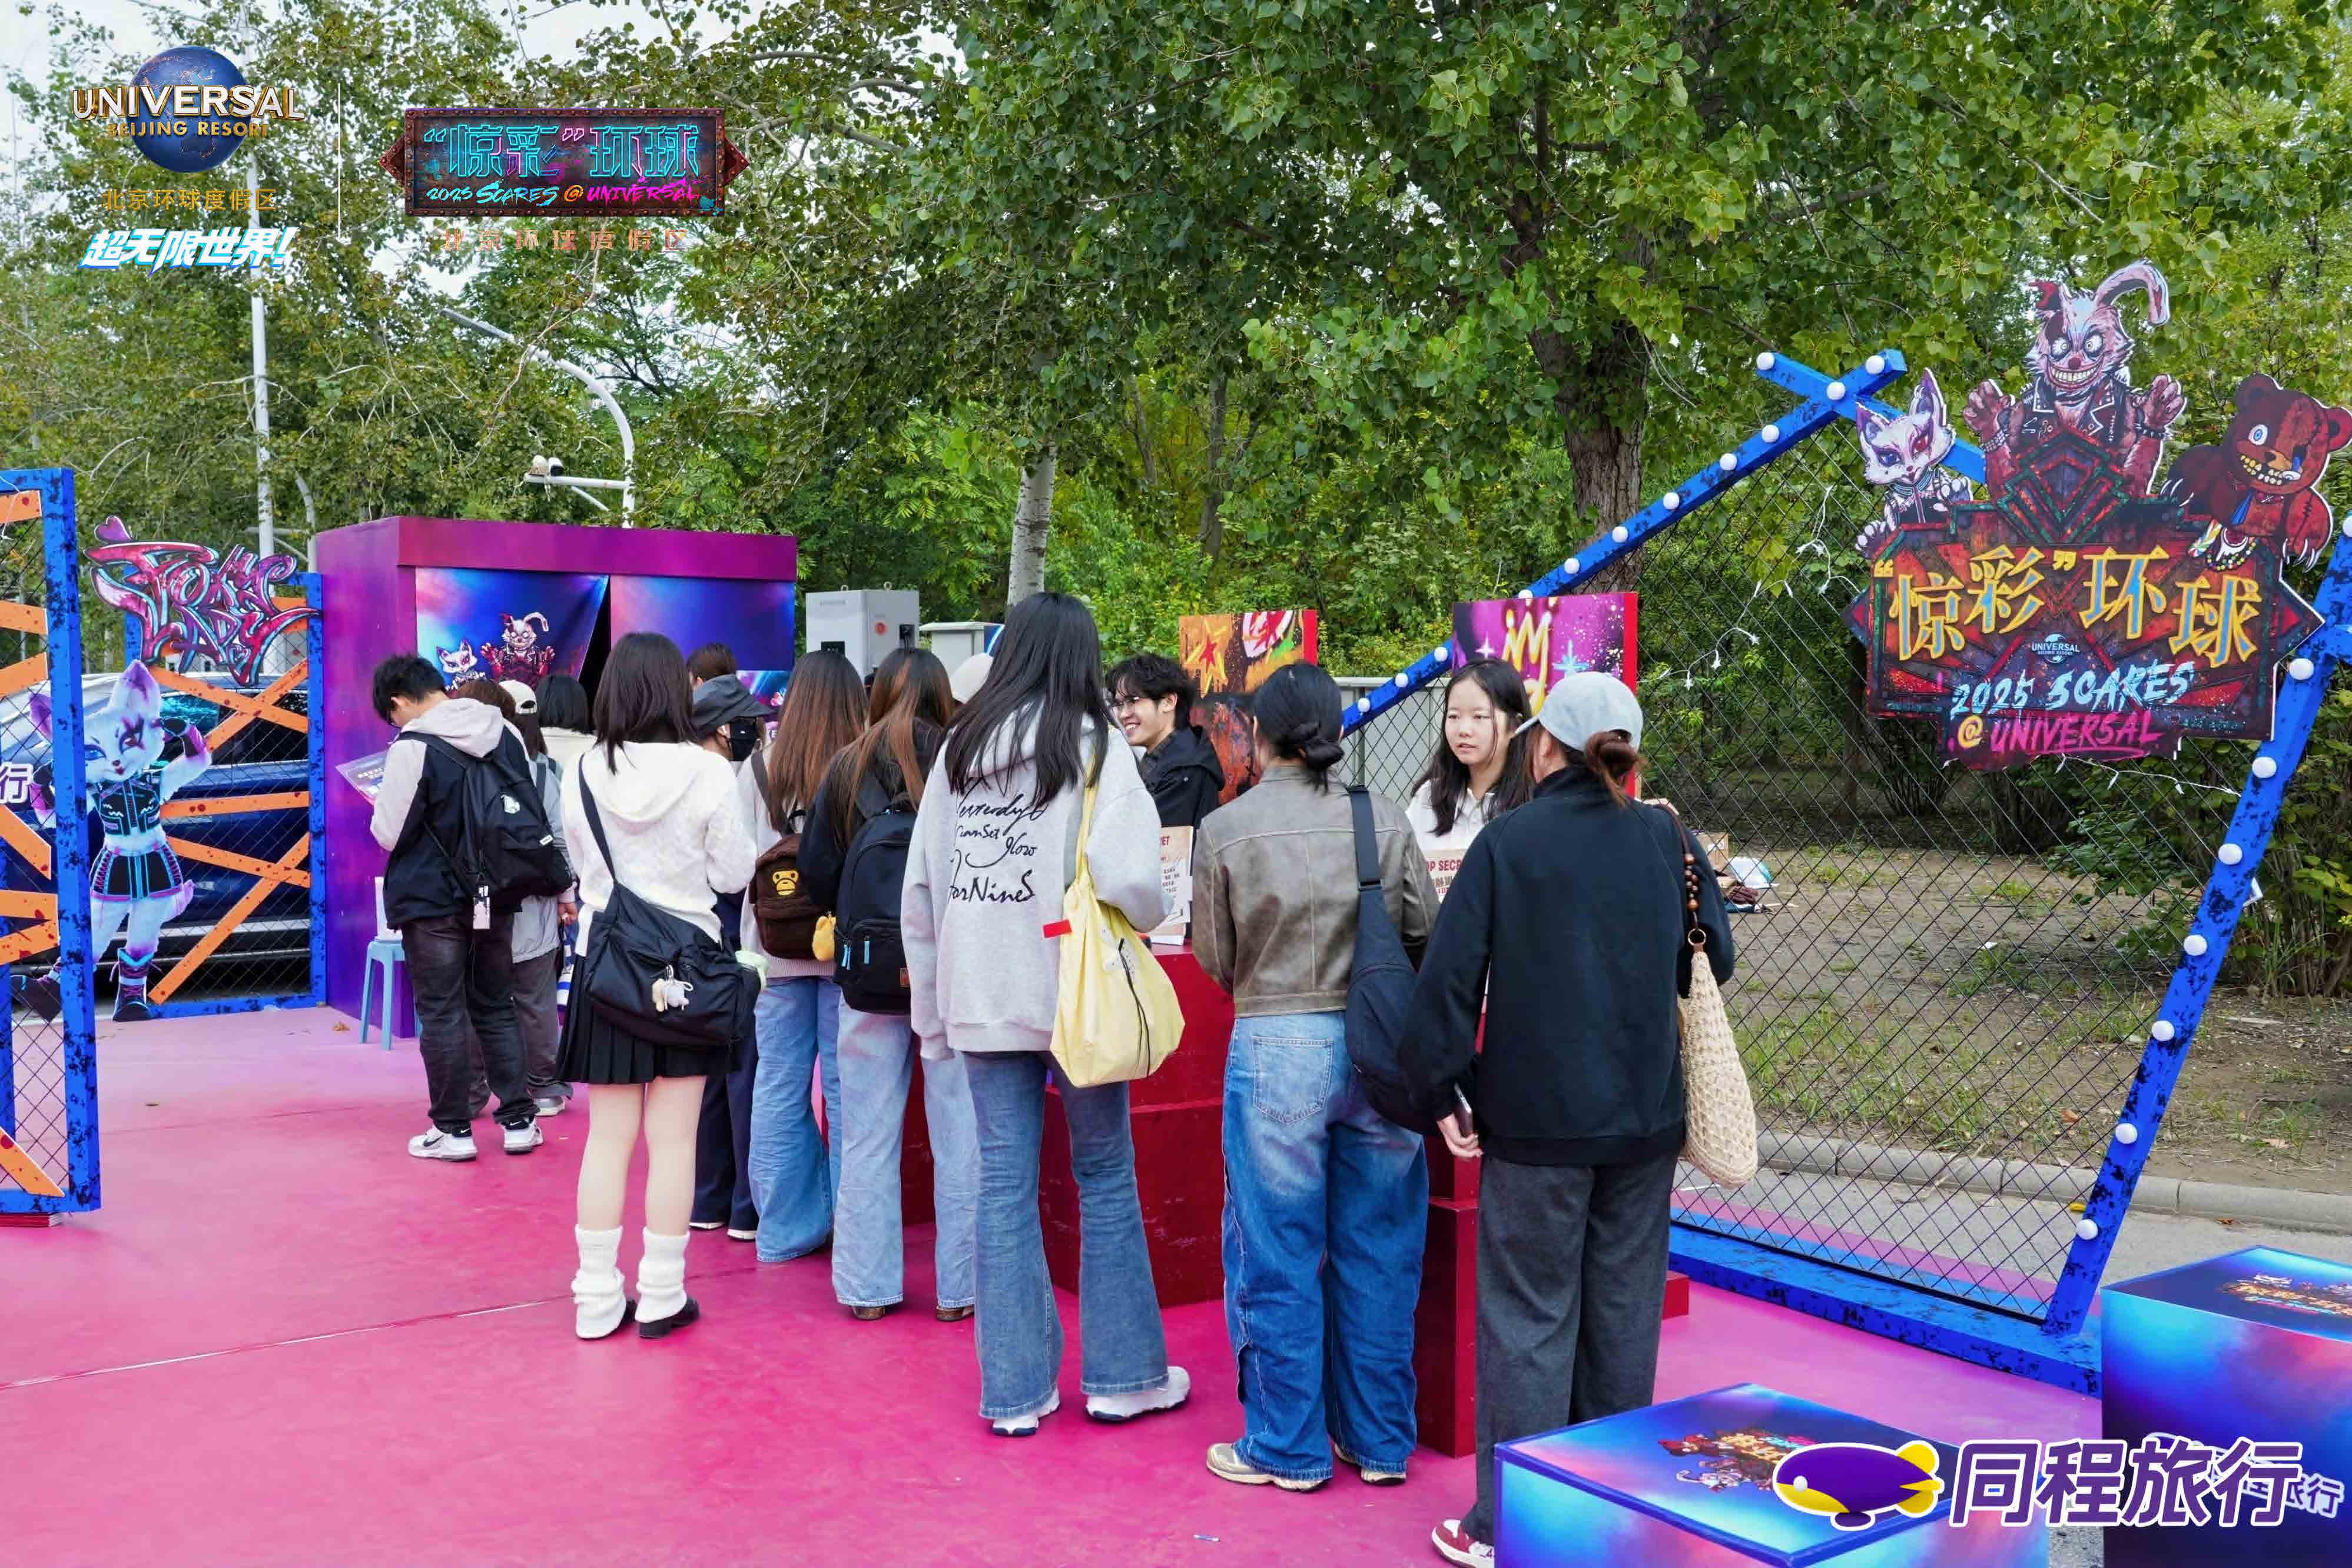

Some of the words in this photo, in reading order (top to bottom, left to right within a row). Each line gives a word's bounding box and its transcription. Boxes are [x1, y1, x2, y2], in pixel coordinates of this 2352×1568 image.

[2031, 642, 2080, 653] UNIVERSAL
[1950, 669, 2035, 720] 2025
[2045, 659, 2195, 713] SCARES
[1958, 715, 1983, 749] @
[1990, 710, 2165, 755] UNIVERSAL
